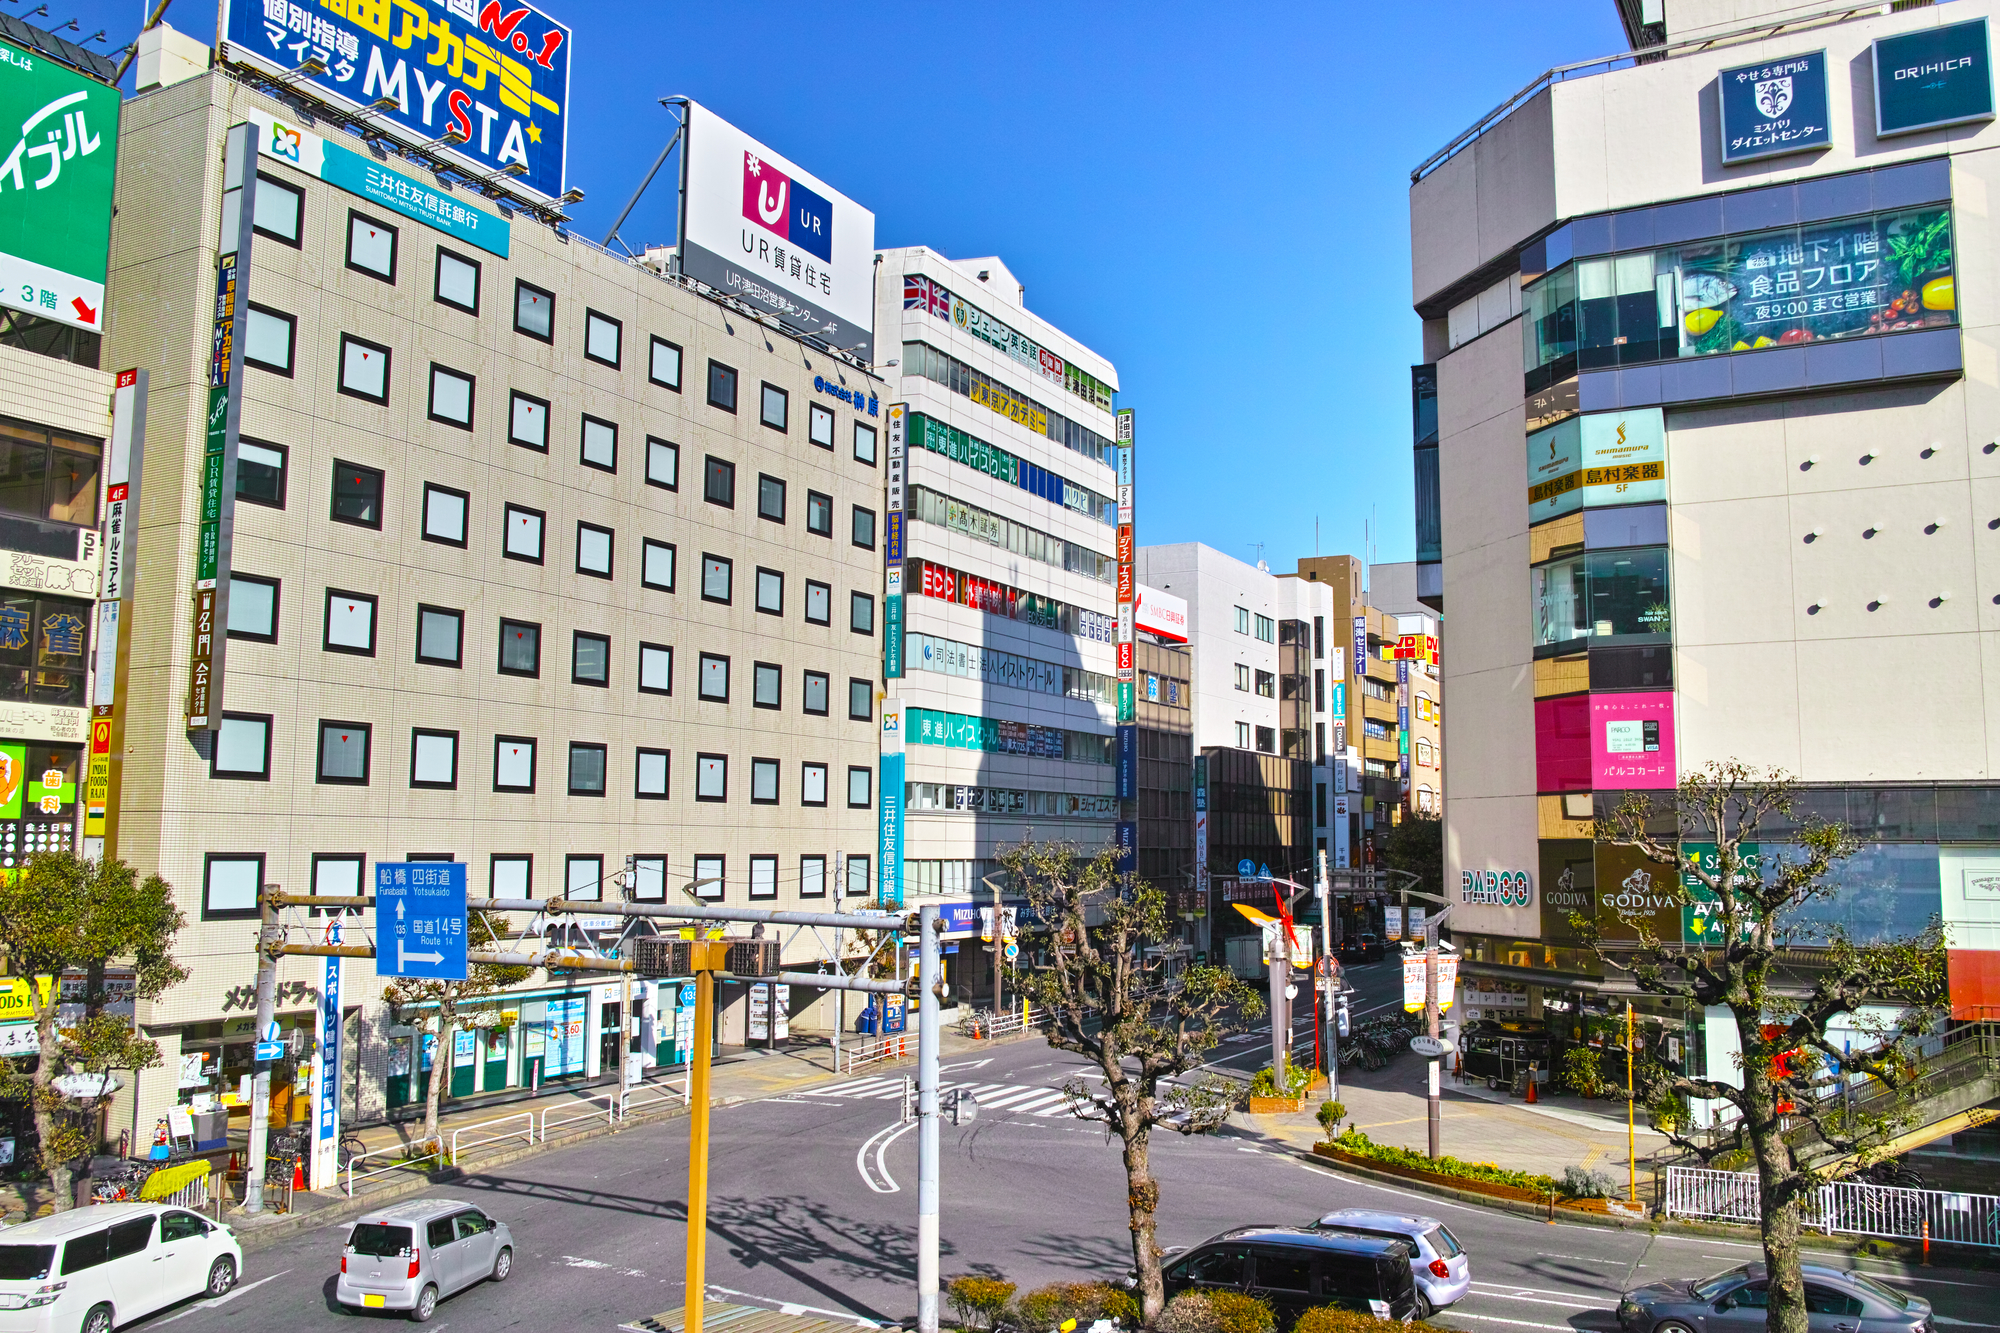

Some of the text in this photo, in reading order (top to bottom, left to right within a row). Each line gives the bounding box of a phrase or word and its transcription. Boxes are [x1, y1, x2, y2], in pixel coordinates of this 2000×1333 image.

[263, 0, 360, 62] 個別指導
[1735, 60, 1809, 84] やせる専門店
[1893, 56, 1972, 81] ORIHICA
[362, 44, 531, 176] MYSTA
[1730, 126, 1824, 151] ダイエットセンター
[1753, 119, 1791, 134] ミスパリ
[365, 166, 479, 230] 三井住友信託銀行
[365, 185, 452, 228] SUMITOMO MITSUI TRUST BANK
[800, 208, 822, 237] UR
[1778, 230, 1880, 267] 地下1階
[741, 228, 832, 297] UR賃貸住宅
[1749, 258, 1880, 299] 食品フロア
[725, 269, 820, 324] UR津田沼営業センター
[970, 310, 1038, 362] シェーン英会話
[211, 327, 223, 387] MYSTA
[121, 374, 132, 387] 5F
[980, 384, 1047, 429] 東京アカデミー
[1123, 414, 1131, 439] 津田沼
[891, 419, 902, 510] 住友不動産販売
[937, 434, 1018, 485] 東進ハイスクール
[1586, 463, 1659, 484] 島村楽器
[112, 490, 124, 502] 4F
[206, 456, 220, 519] UR賃貸住宅
[1063, 484, 1089, 511] ハクビ
[1534, 474, 1575, 501] 島村楽器
[1615, 483, 1629, 493] 5F
[1550, 496, 1558, 507] 5F
[11, 553, 45, 566] フリー
[107, 502, 123, 598] 麻雀ルミアキ
[11, 564, 44, 578] セット
[924, 570, 955, 597] ECC
[1150, 604, 1185, 627] SMBC日興証券
[1637, 615, 1661, 623] SWAN
[198, 611, 211, 686] 名門会
[1355, 617, 1365, 674] 臨海セミナー
[935, 646, 1054, 687] 司法書士法人イストワール
[98, 705, 109, 716] 3F
[922, 718, 998, 746] 東進ハイスクール
[90, 776, 108, 788] FOODS
[92, 764, 107, 775] INDIA
[1603, 765, 1666, 777] パルコカード
[40, 770, 63, 813] 歯科
[90, 787, 106, 799] RAJA
[955, 786, 1025, 810] テナント募集中
[882, 795, 896, 908] 三井住友信託銀行
[380, 868, 451, 886] 船橋 四街道
[1461, 869, 1532, 907] PARCO
[379, 886, 451, 897] Funabashi Yotsukaido
[1546, 891, 1588, 906] GODIVA
[1602, 893, 1675, 908] GODIVA
[395, 924, 406, 935] 135
[413, 917, 463, 936] 国道14号
[420, 935, 453, 946] Route 14
[322, 965, 338, 1127] スポーツ健康都市宣言
